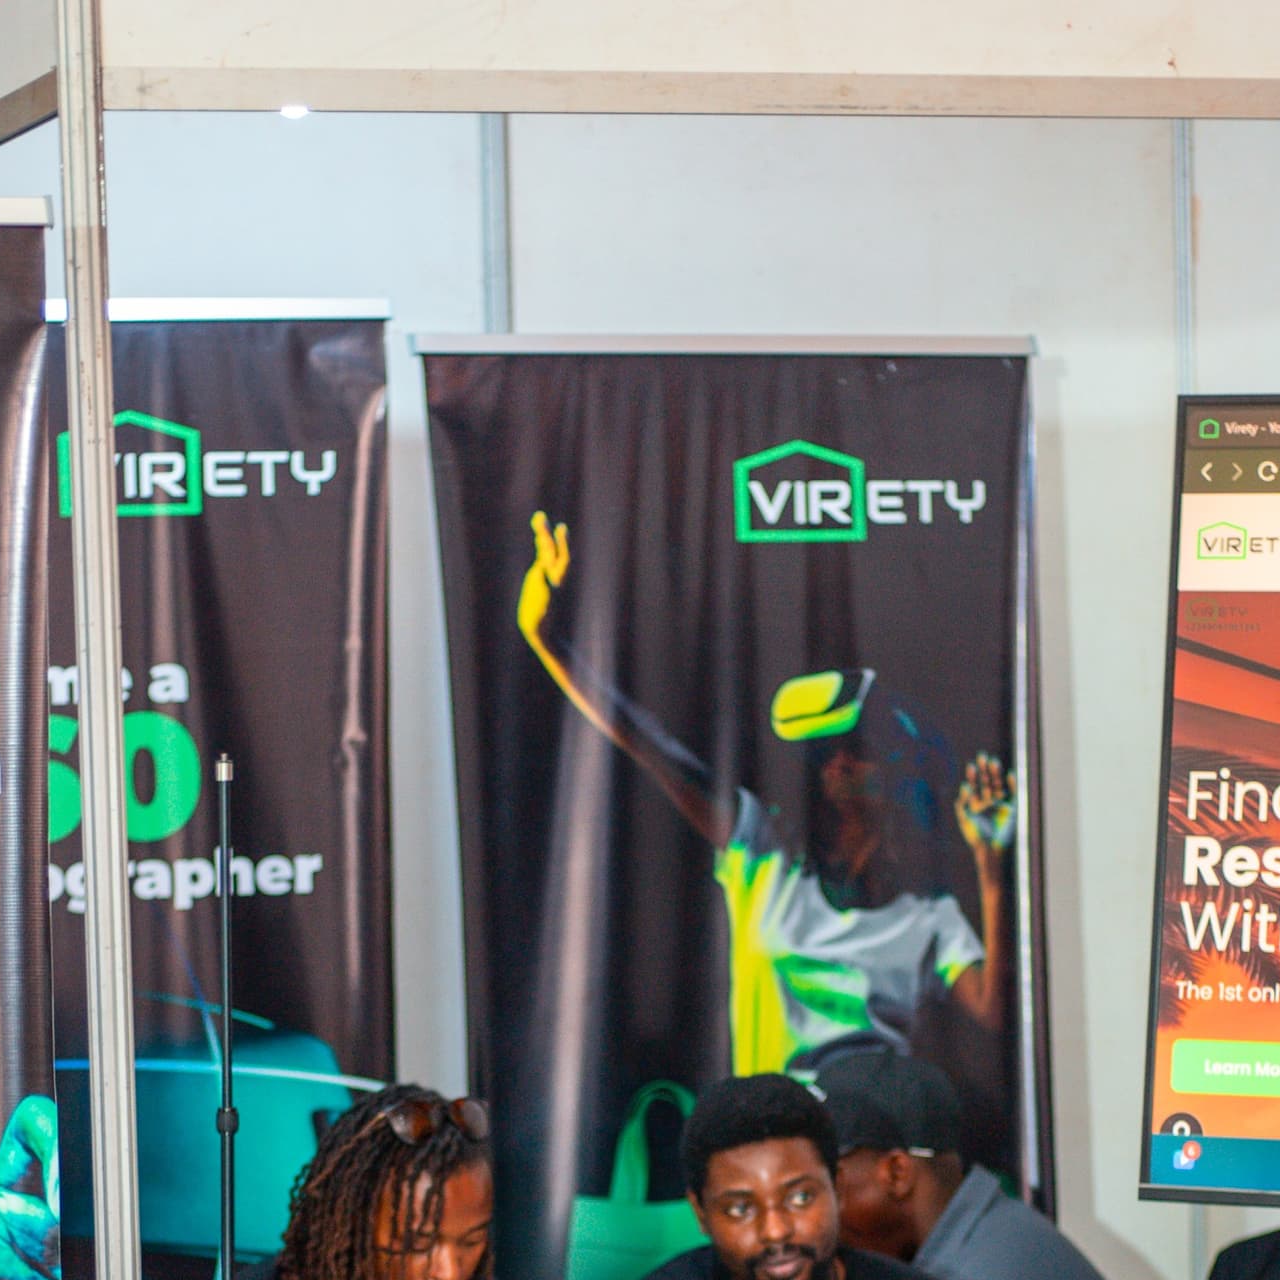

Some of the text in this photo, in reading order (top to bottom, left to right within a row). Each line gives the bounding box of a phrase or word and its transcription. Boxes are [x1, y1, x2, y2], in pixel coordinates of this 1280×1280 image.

[1223, 421, 1259, 438] Virety
[113, 449, 338, 498] IRETY
[746, 479, 987, 525] VIRETY
[147, 663, 190, 704] a
[1176, 980, 1213, 1001] The
[1219, 982, 1243, 1002] 1st
[1204, 1058, 1251, 1077] Learn
